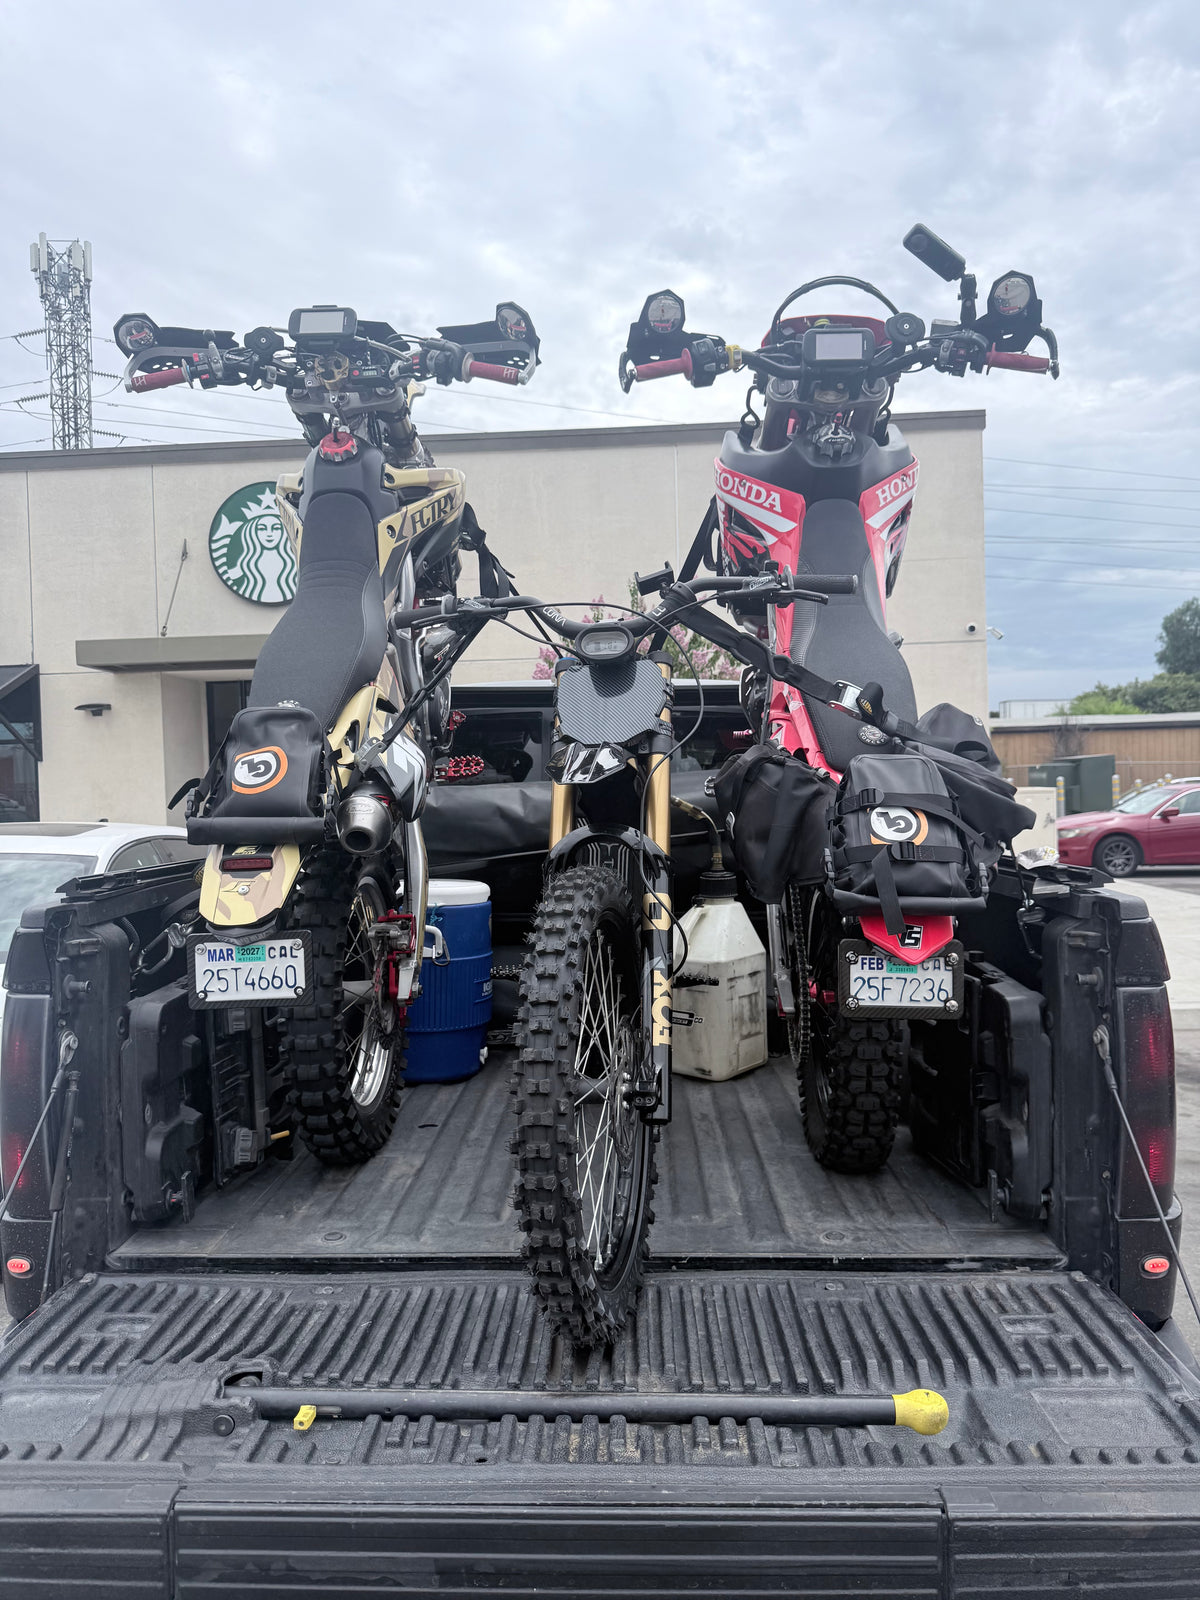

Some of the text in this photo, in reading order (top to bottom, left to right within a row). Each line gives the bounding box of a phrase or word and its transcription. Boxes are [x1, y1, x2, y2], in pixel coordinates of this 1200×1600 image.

[715, 468, 783, 514] HONDA
[207, 945, 298, 962] MAR 2027 CAL
[860, 957, 884, 971] FEB
[921, 958, 952, 972] CAL
[202, 964, 298, 993] 25T4660
[853, 976, 949, 1002] 25F7236
[651, 970, 673, 1047] FOX
